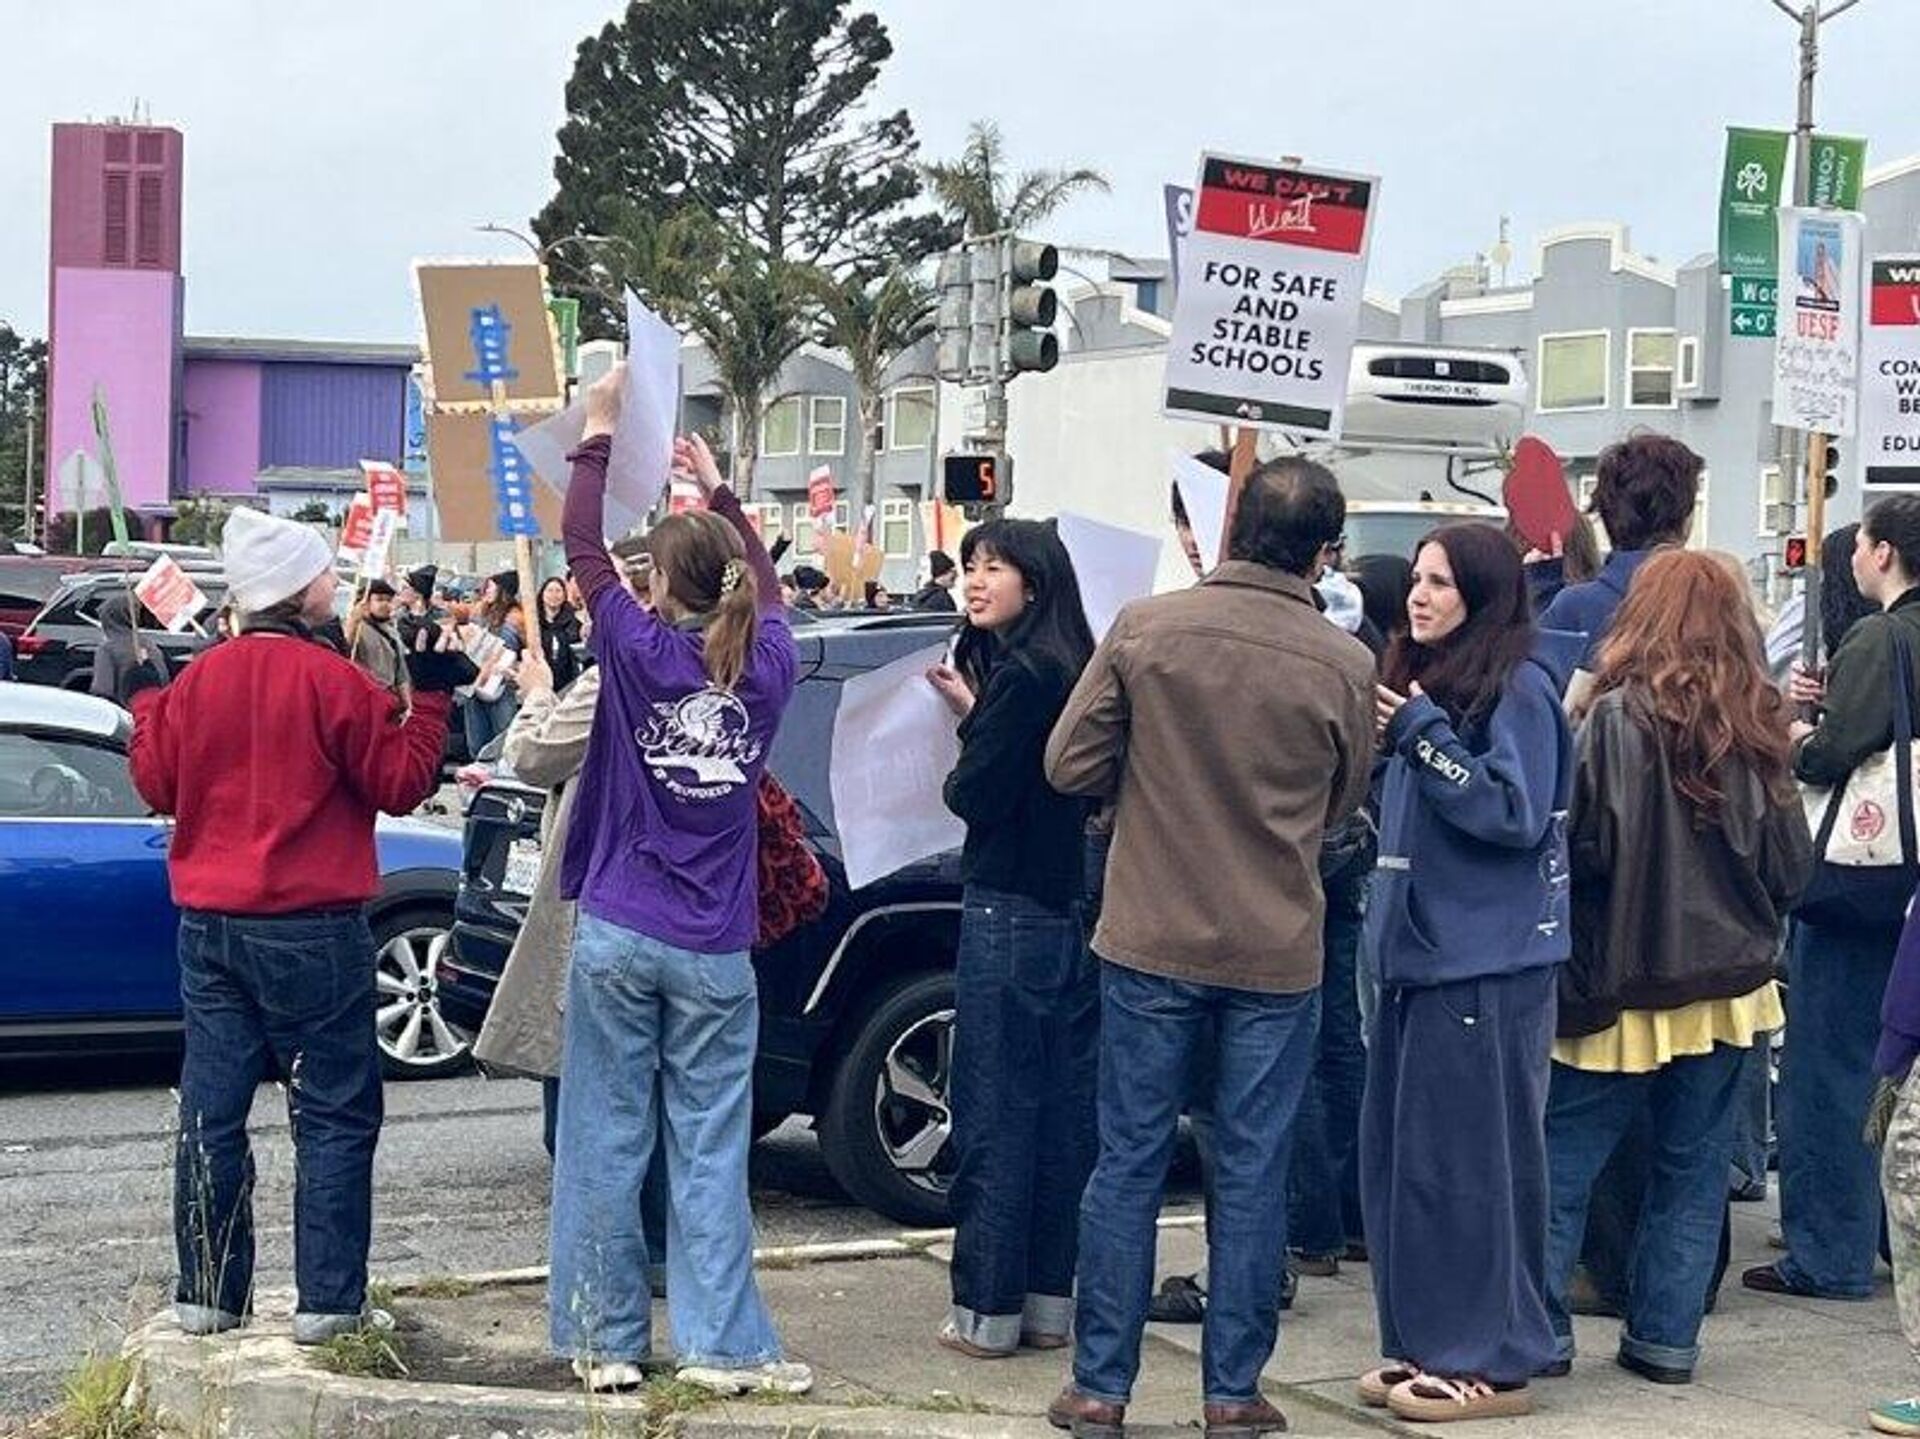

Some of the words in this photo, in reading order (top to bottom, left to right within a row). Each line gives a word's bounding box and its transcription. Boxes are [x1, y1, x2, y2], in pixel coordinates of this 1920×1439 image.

[1223, 166, 1270, 191] WE
[1205, 261, 1261, 290] FOR
[1271, 271, 1337, 301] SAFE
[1233, 295, 1299, 321] AND
[1213, 318, 1311, 351] STABLE
[1190, 342, 1323, 381] SCHOOLS
[1896, 379, 1920, 395] W
[980, 463, 994, 496] 5
[1432, 752, 1470, 786] LOVE
